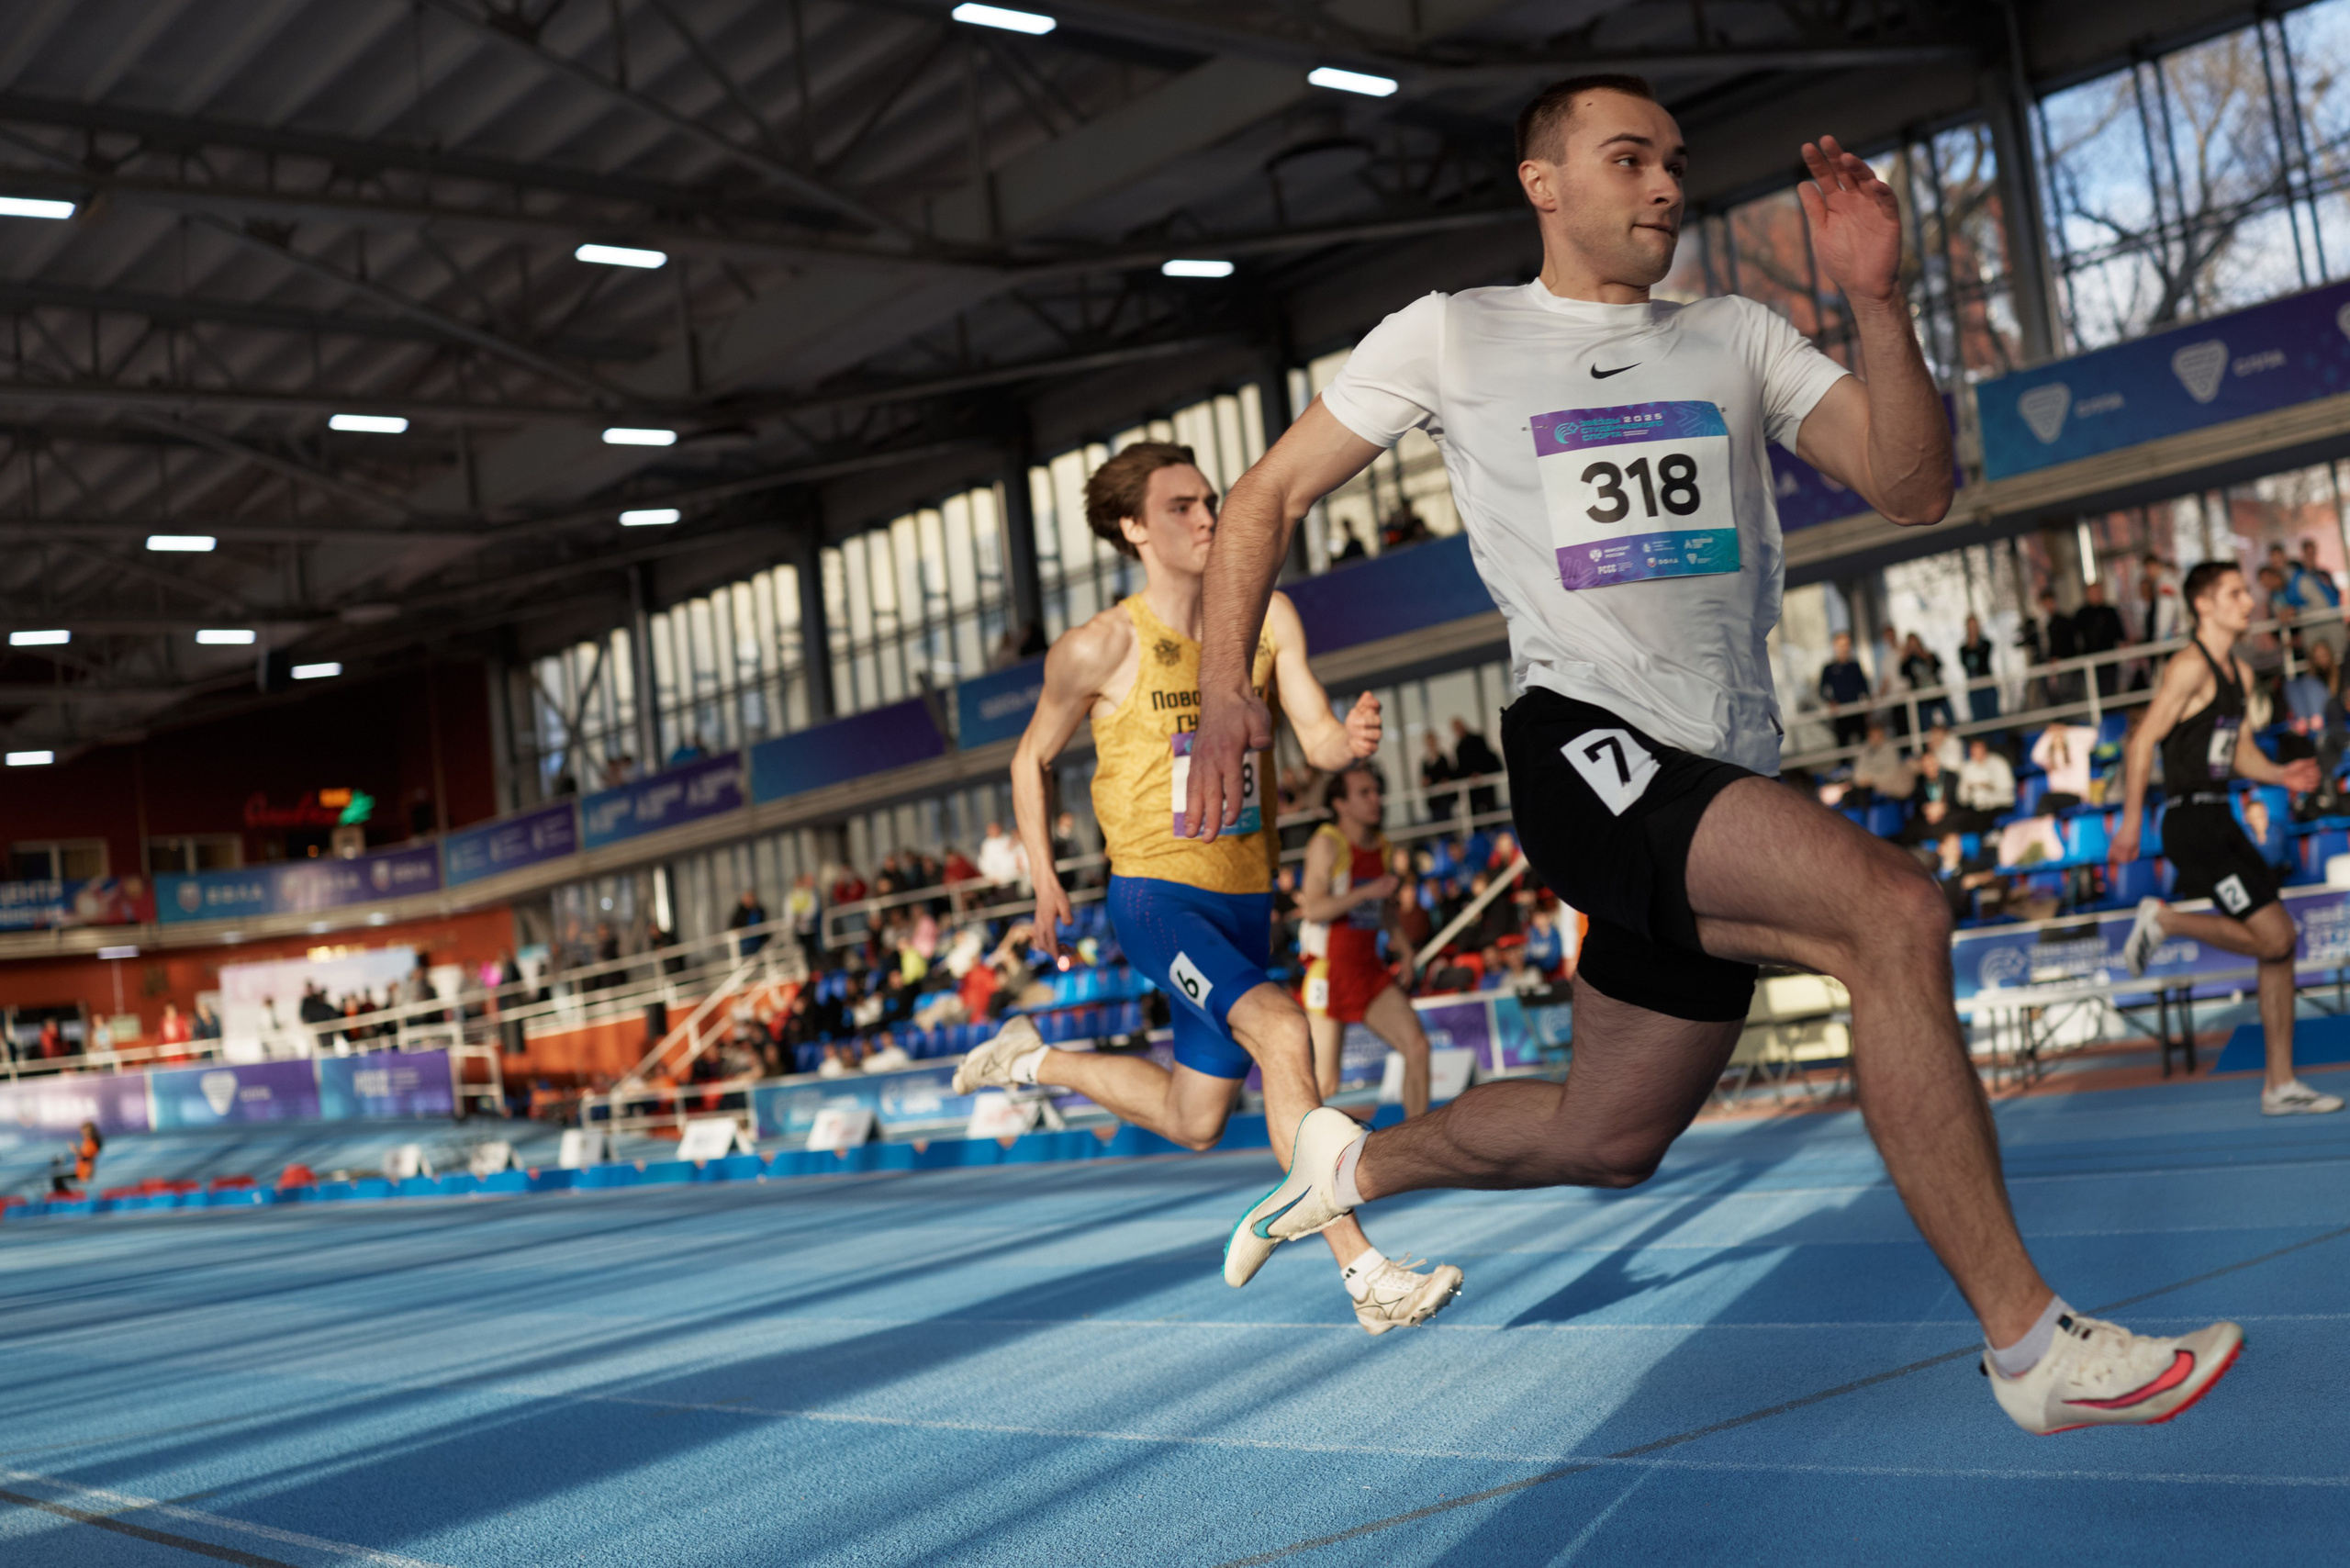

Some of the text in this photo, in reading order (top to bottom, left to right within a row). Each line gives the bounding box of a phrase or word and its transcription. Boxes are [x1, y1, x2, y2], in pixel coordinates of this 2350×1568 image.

[1623, 412, 1662, 423] 2025
[1582, 431, 1623, 442] СПОРТА
[1580, 454, 1701, 523] 318
[1583, 736, 1631, 788] 7
[2224, 885, 2243, 906] 2
[1177, 969, 1199, 999] 6
